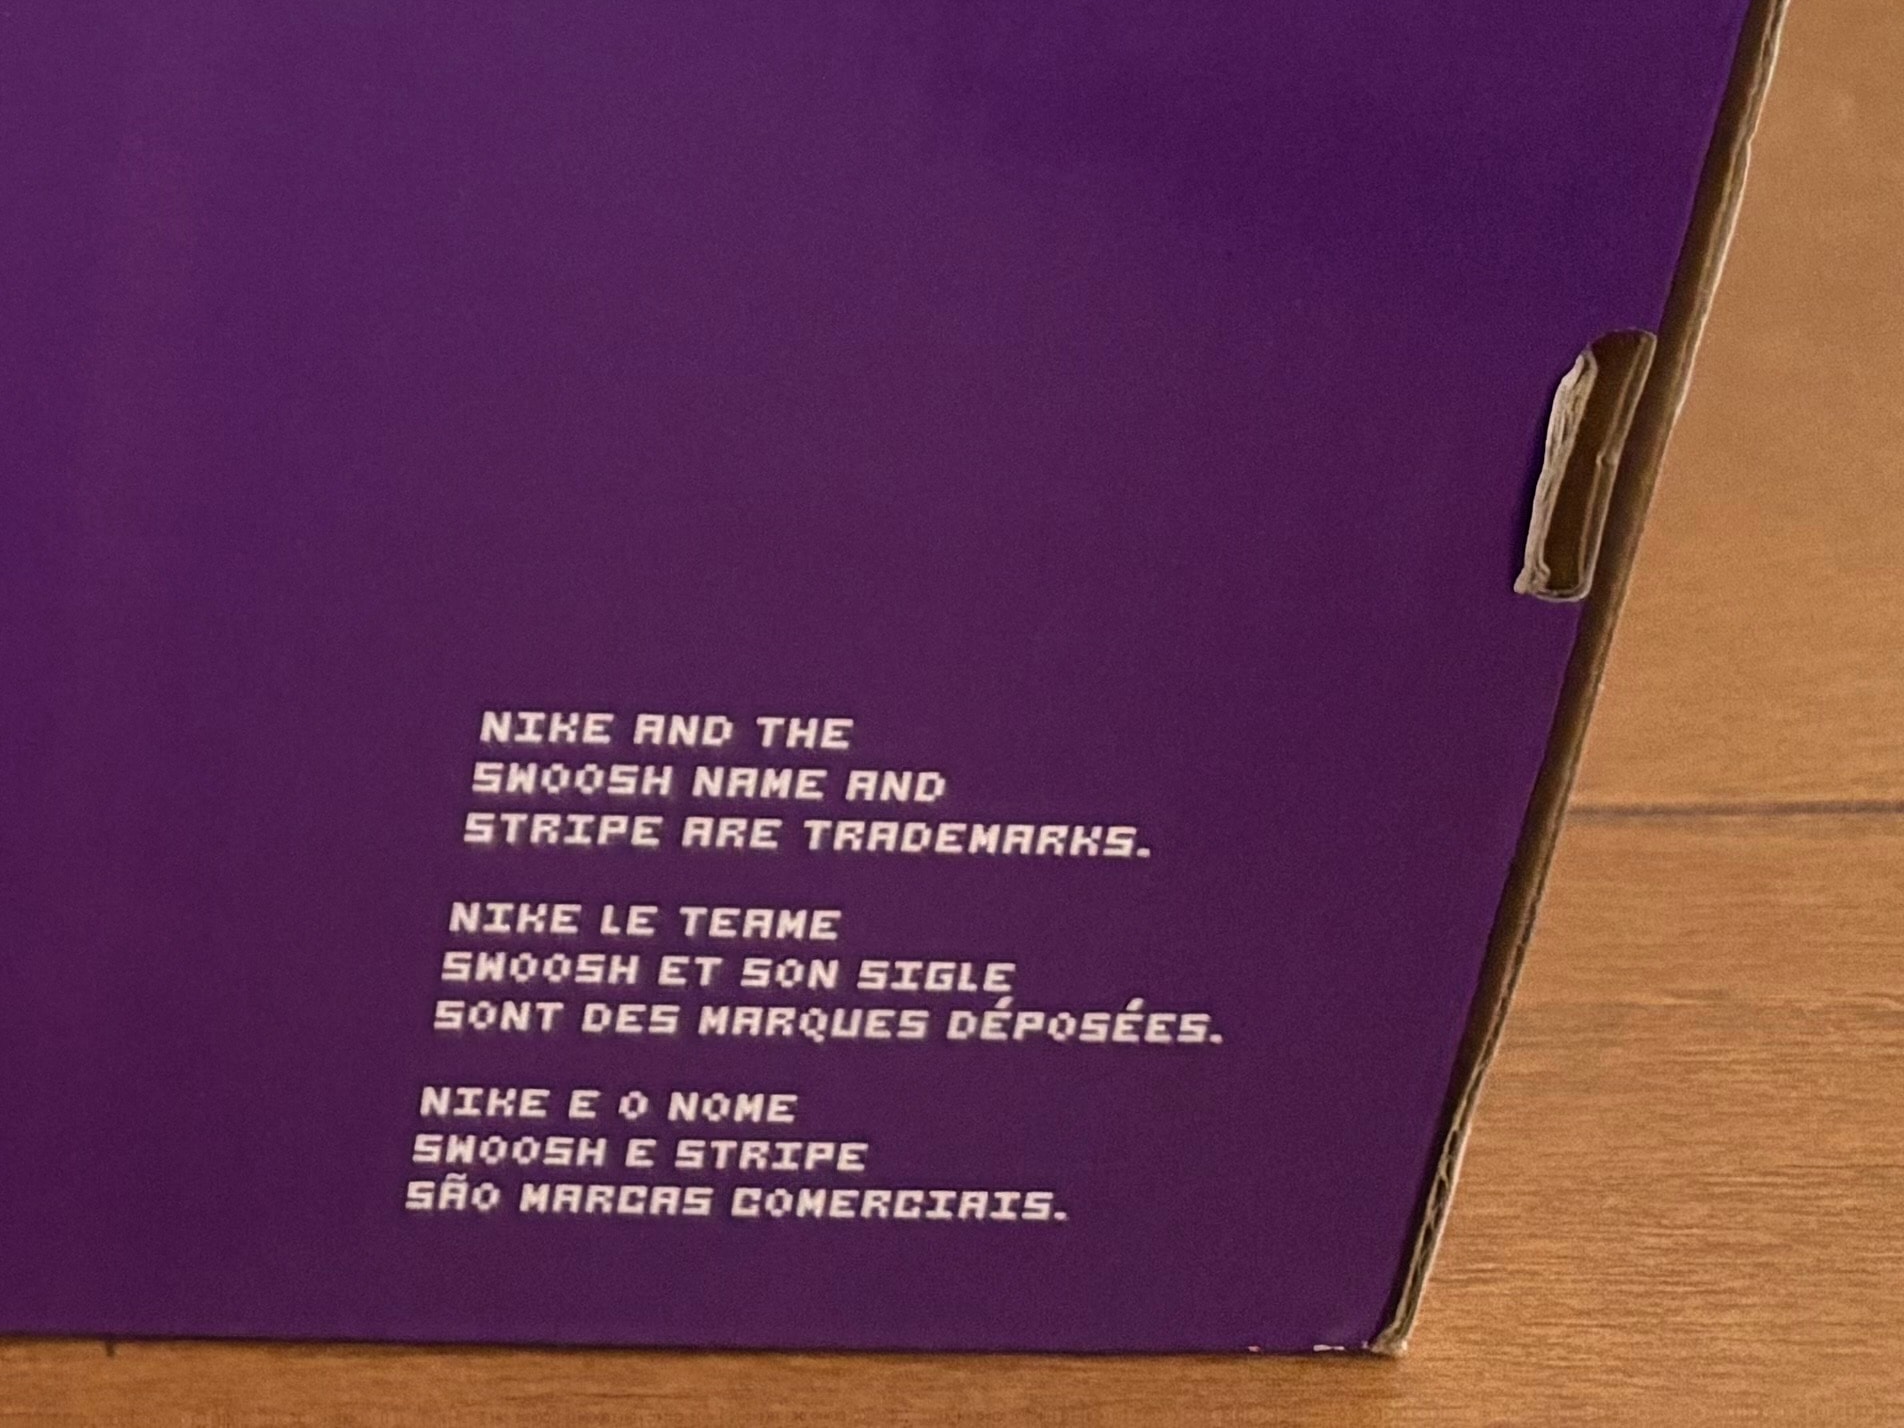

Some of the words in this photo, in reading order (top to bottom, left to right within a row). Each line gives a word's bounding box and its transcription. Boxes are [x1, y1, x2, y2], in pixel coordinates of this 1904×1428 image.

[478, 710, 616, 746] NIKE
[632, 712, 735, 748] AND
[755, 715, 855, 751] THE
[470, 760, 674, 797] SWOOSH
[691, 765, 829, 802] NAME
[844, 769, 947, 804] AND
[462, 811, 665, 849] STRIPE
[680, 815, 784, 851] ARE
[802, 818, 1152, 859] TRADEMARKS.
[448, 900, 583, 936] NIKE
[599, 903, 660, 938] LE
[440, 950, 641, 986] SWOOSH
[657, 954, 725, 988] ET
[739, 956, 840, 991] SON
[855, 958, 1017, 994] SIGLE
[432, 999, 566, 1033] SONT
[580, 1001, 682, 1036] DES
[697, 1004, 931, 1044] MARQUES
[945, 994, 1224, 1045] DÉPOSÉES.
[418, 1085, 552, 1119] NIKE
[567, 1088, 602, 1120] E
[617, 1089, 650, 1121] O
[666, 1090, 799, 1125] NOME
[411, 1132, 608, 1168] SWOOSH
[624, 1137, 658, 1169] E
[673, 1138, 870, 1173] STRIPE
[404, 1171, 502, 1213] SÃO
[518, 1182, 715, 1217] MARCAS
[730, 1186, 1068, 1222] COMERCIAIS.
